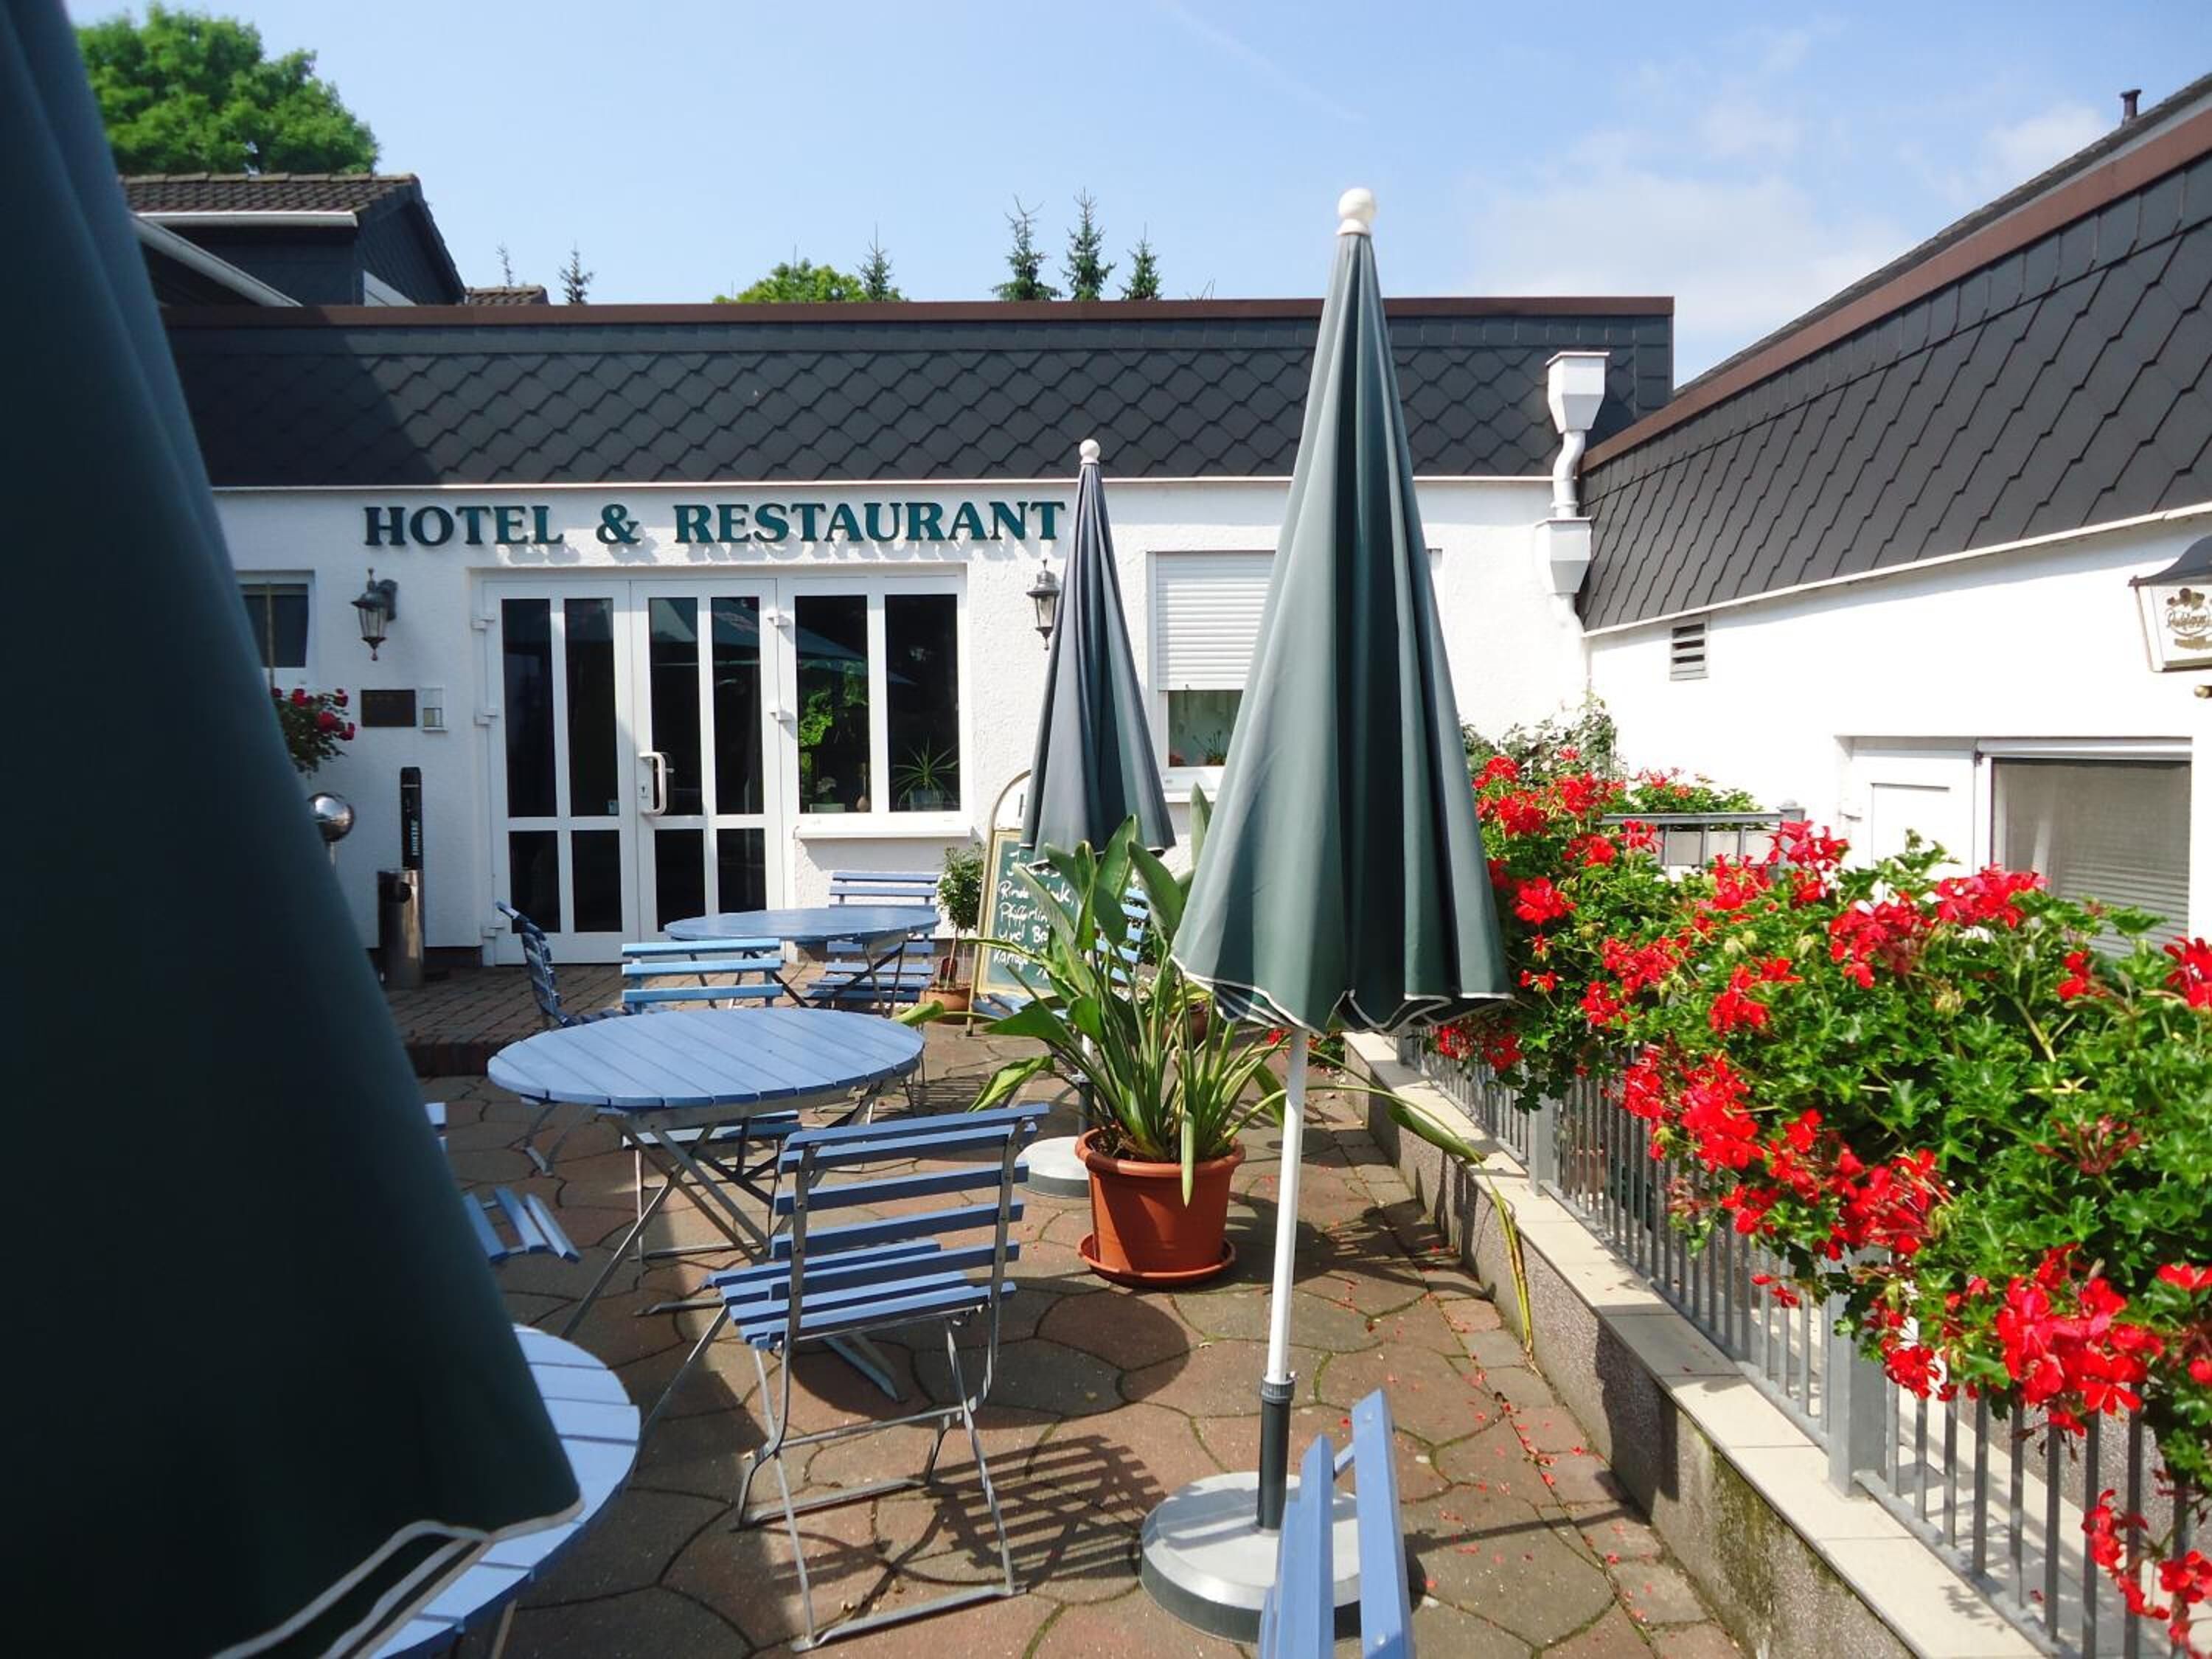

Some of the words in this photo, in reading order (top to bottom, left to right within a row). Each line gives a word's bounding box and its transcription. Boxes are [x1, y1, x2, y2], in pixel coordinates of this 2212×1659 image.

[364, 505, 563, 548] HOTEL
[597, 504, 641, 545] &
[674, 502, 1065, 544] RESTAURANT
